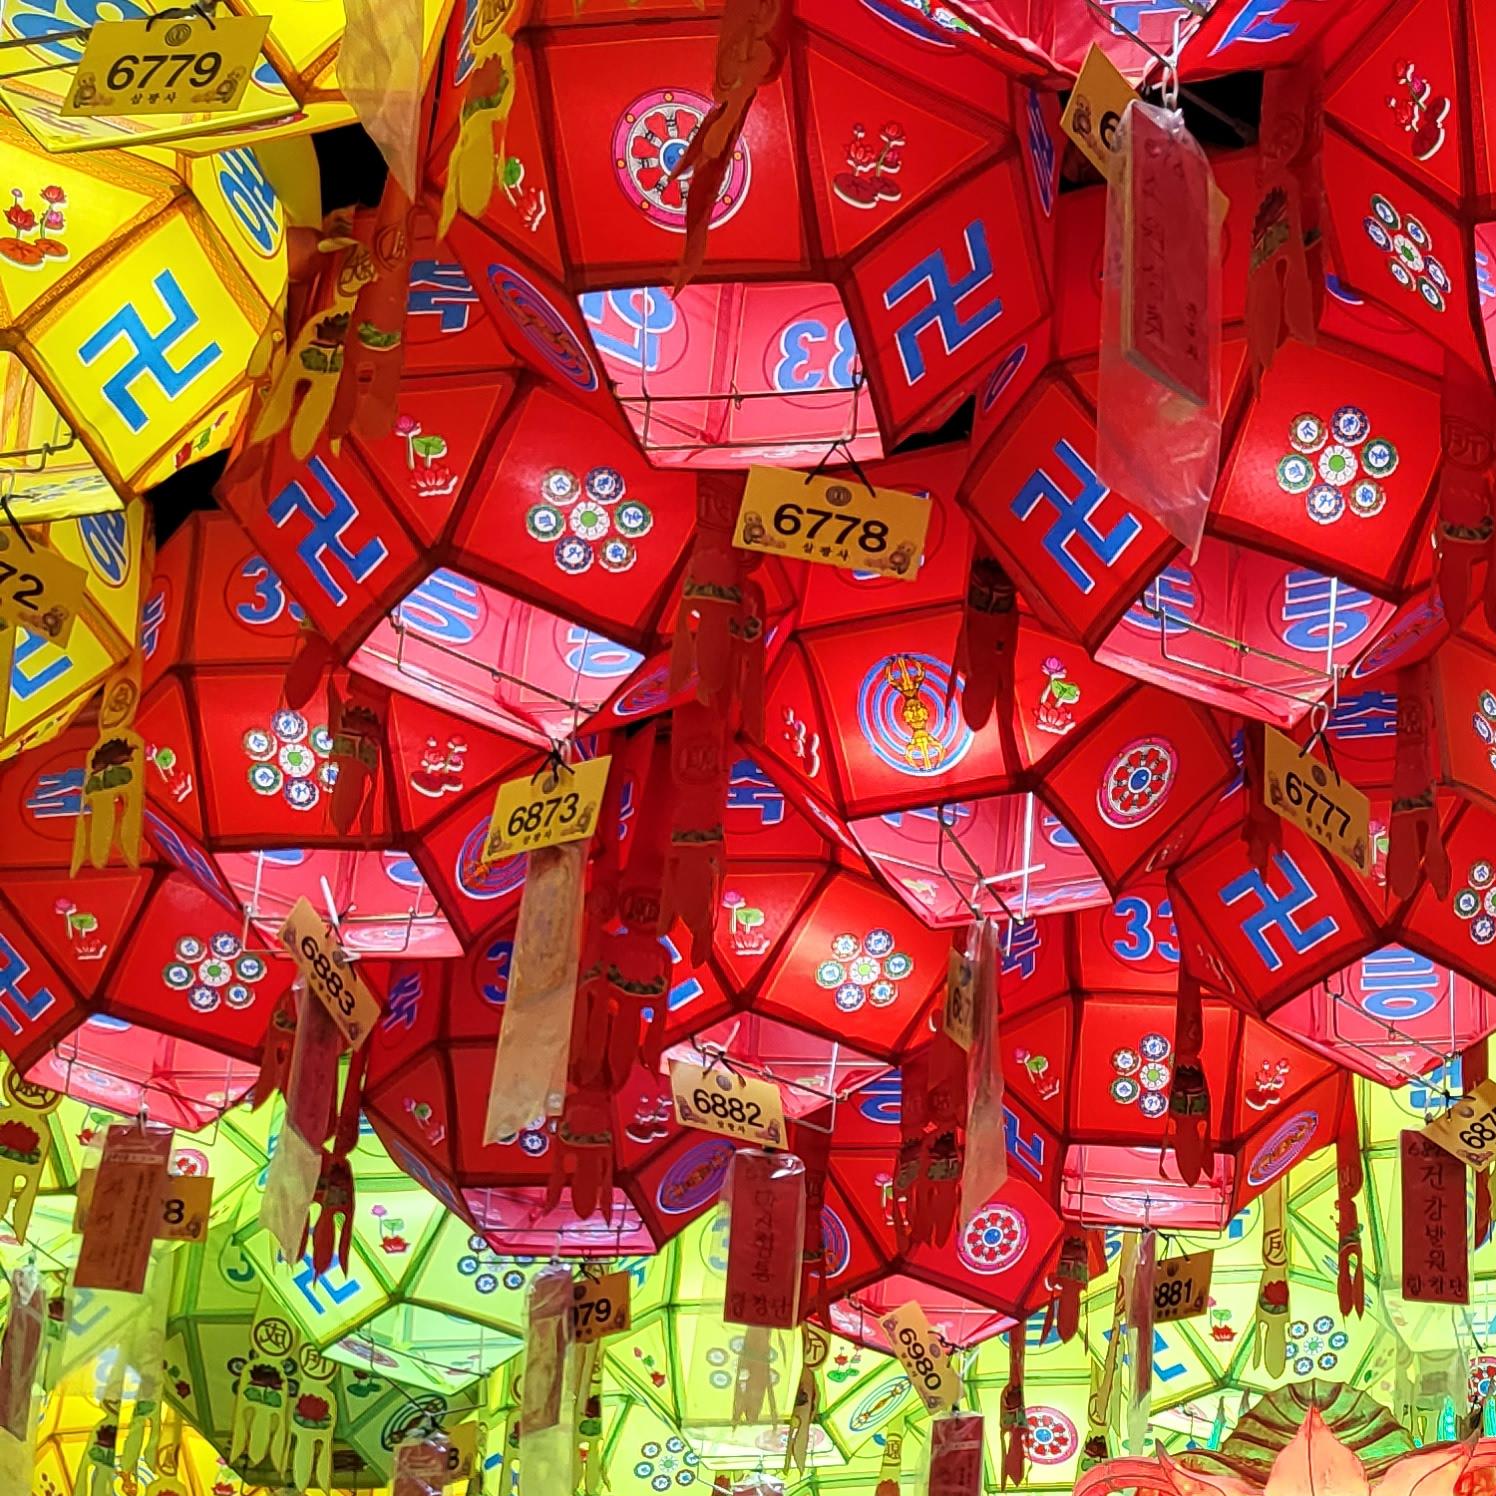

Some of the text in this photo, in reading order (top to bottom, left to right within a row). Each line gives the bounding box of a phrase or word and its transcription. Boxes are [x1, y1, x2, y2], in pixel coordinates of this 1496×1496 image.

[106, 51, 223, 92] 6779
[773, 503, 890, 554] 6778
[507, 792, 580, 836] 6873
[1286, 771, 1352, 837] 6777
[300, 935, 356, 1017] 6883
[694, 1088, 764, 1129] 6882
[1153, 1280, 1193, 1309] 881
[901, 1327, 942, 1391] 6980
